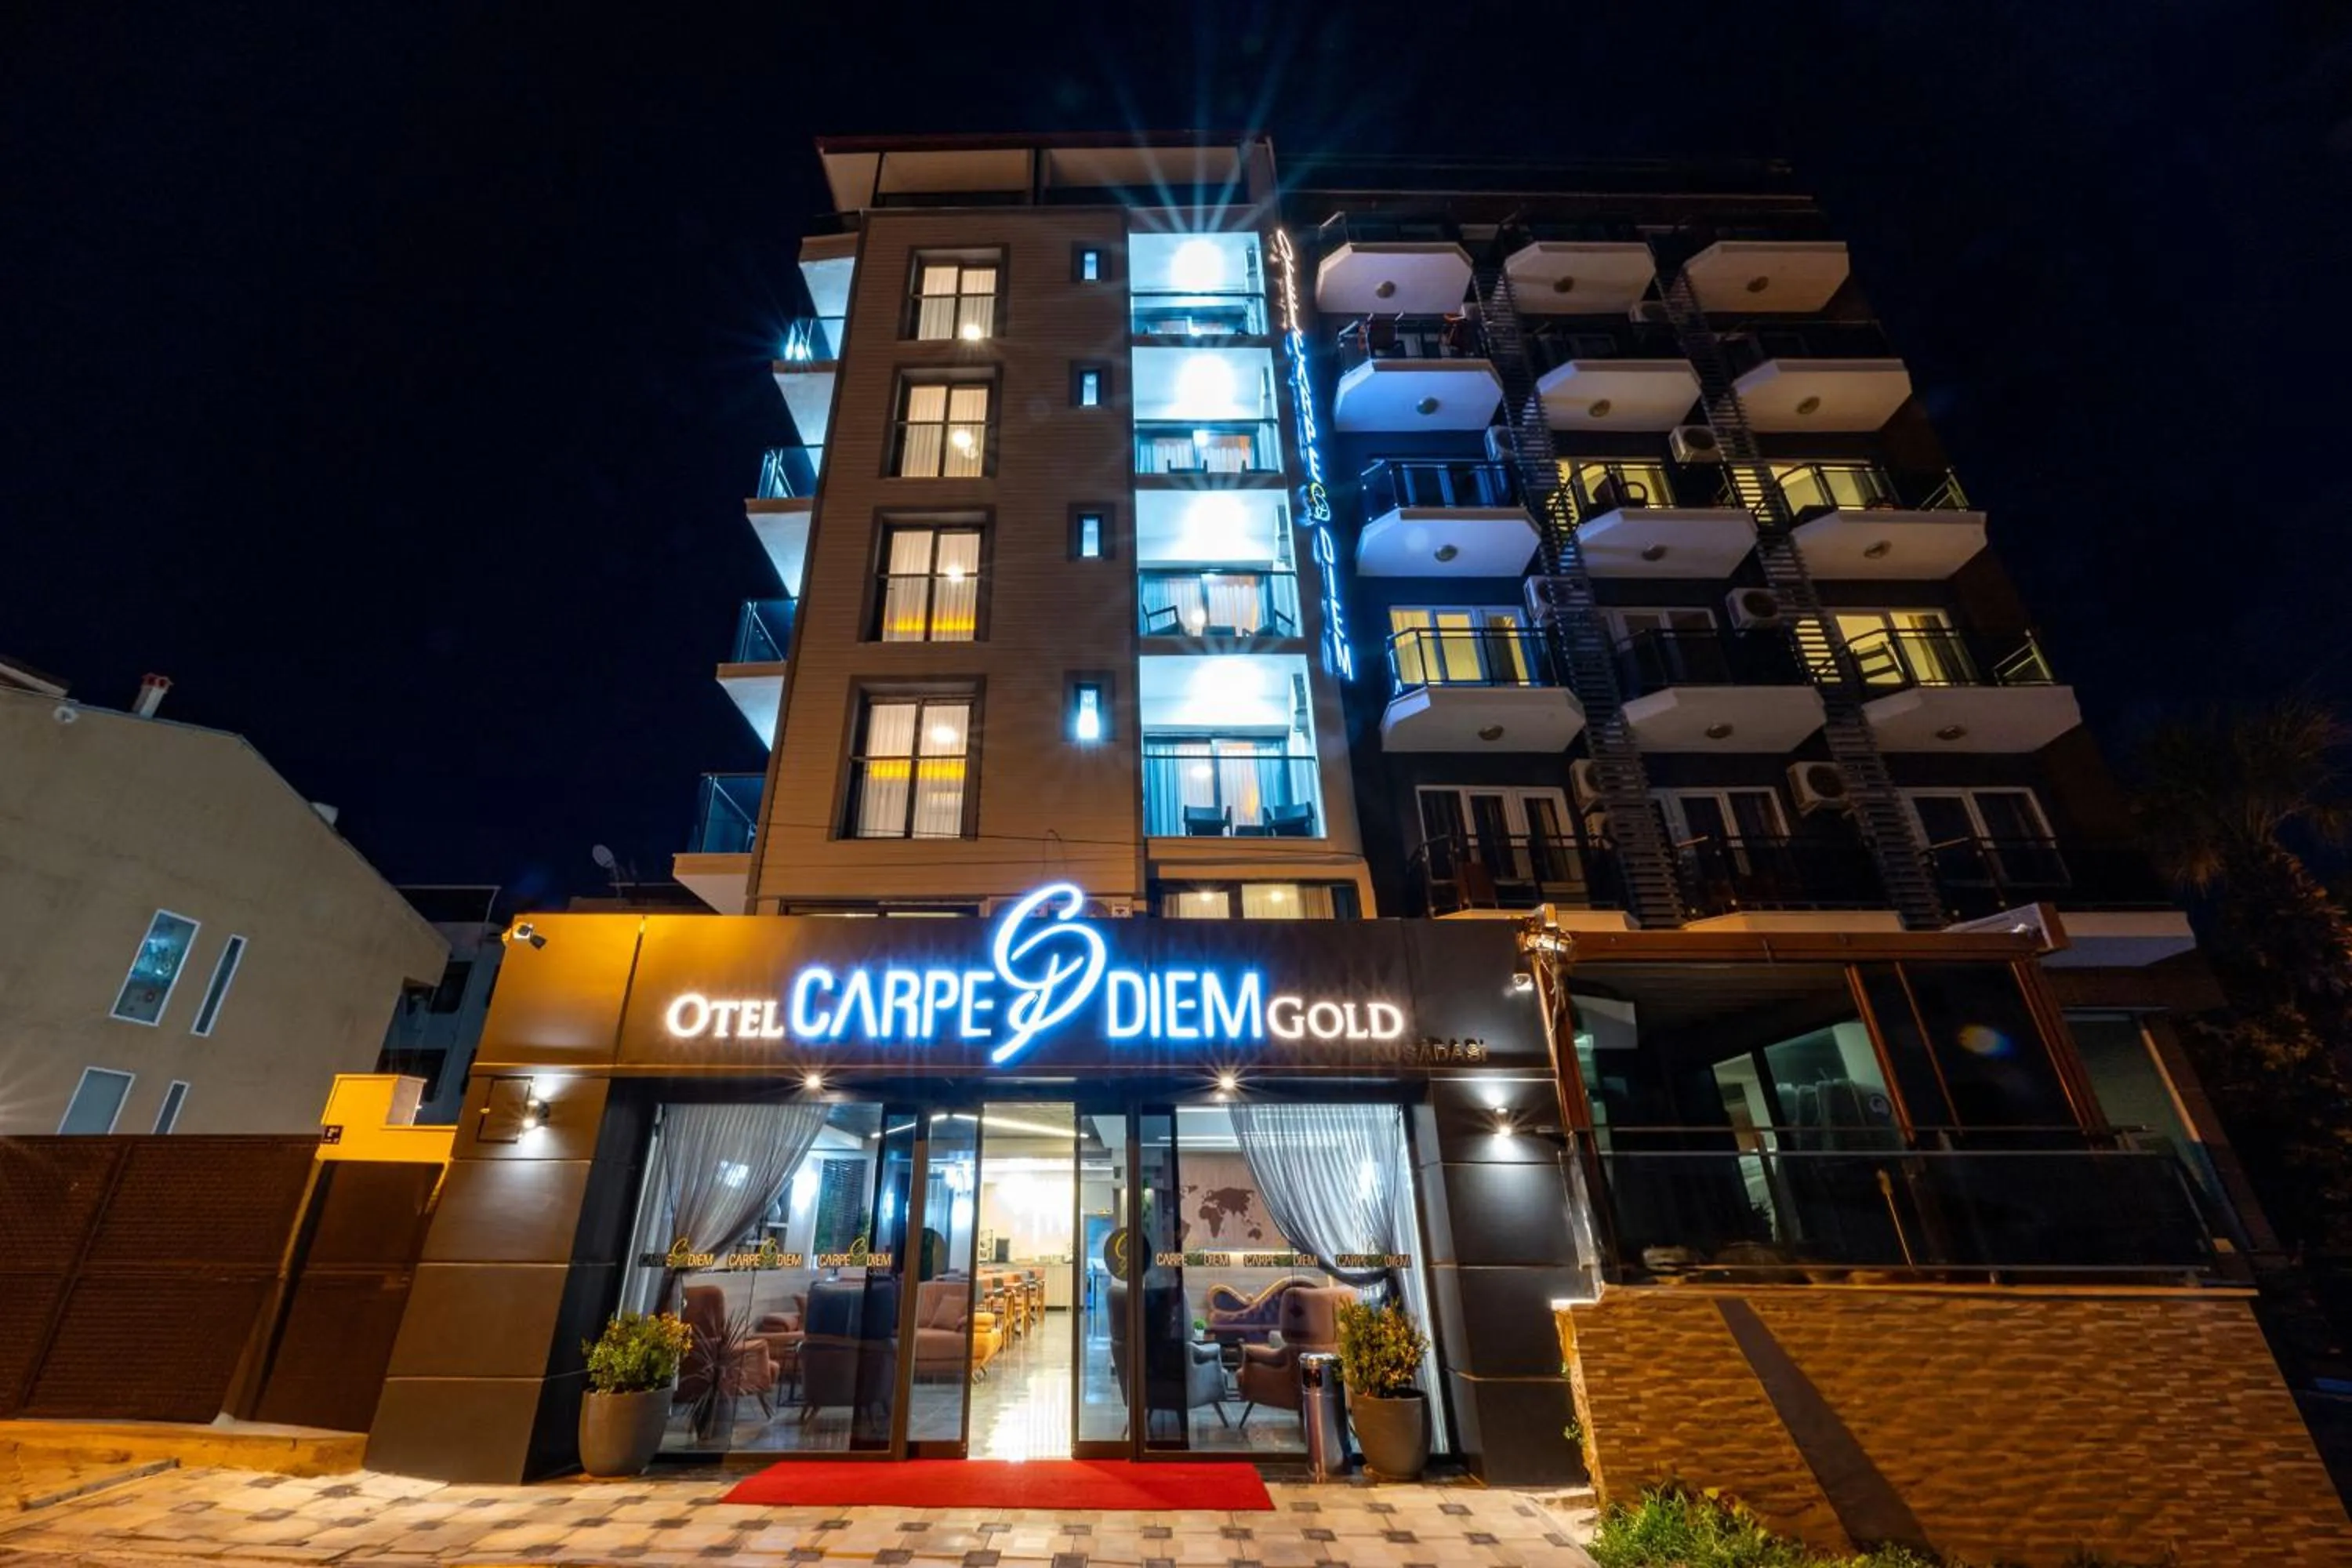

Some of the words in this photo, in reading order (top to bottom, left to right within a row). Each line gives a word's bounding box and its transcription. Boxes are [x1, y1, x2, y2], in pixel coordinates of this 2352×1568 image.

[666, 993, 784, 1038] OTEL
[790, 967, 996, 1039] CARPE
[1106, 971, 1263, 1039] DIEM
[1267, 996, 1405, 1040] GOLD
[728, 1254, 760, 1267] CARPE
[776, 1254, 803, 1267] DIEM
[817, 1254, 850, 1267] CARPE
[866, 1254, 892, 1267] DIEM
